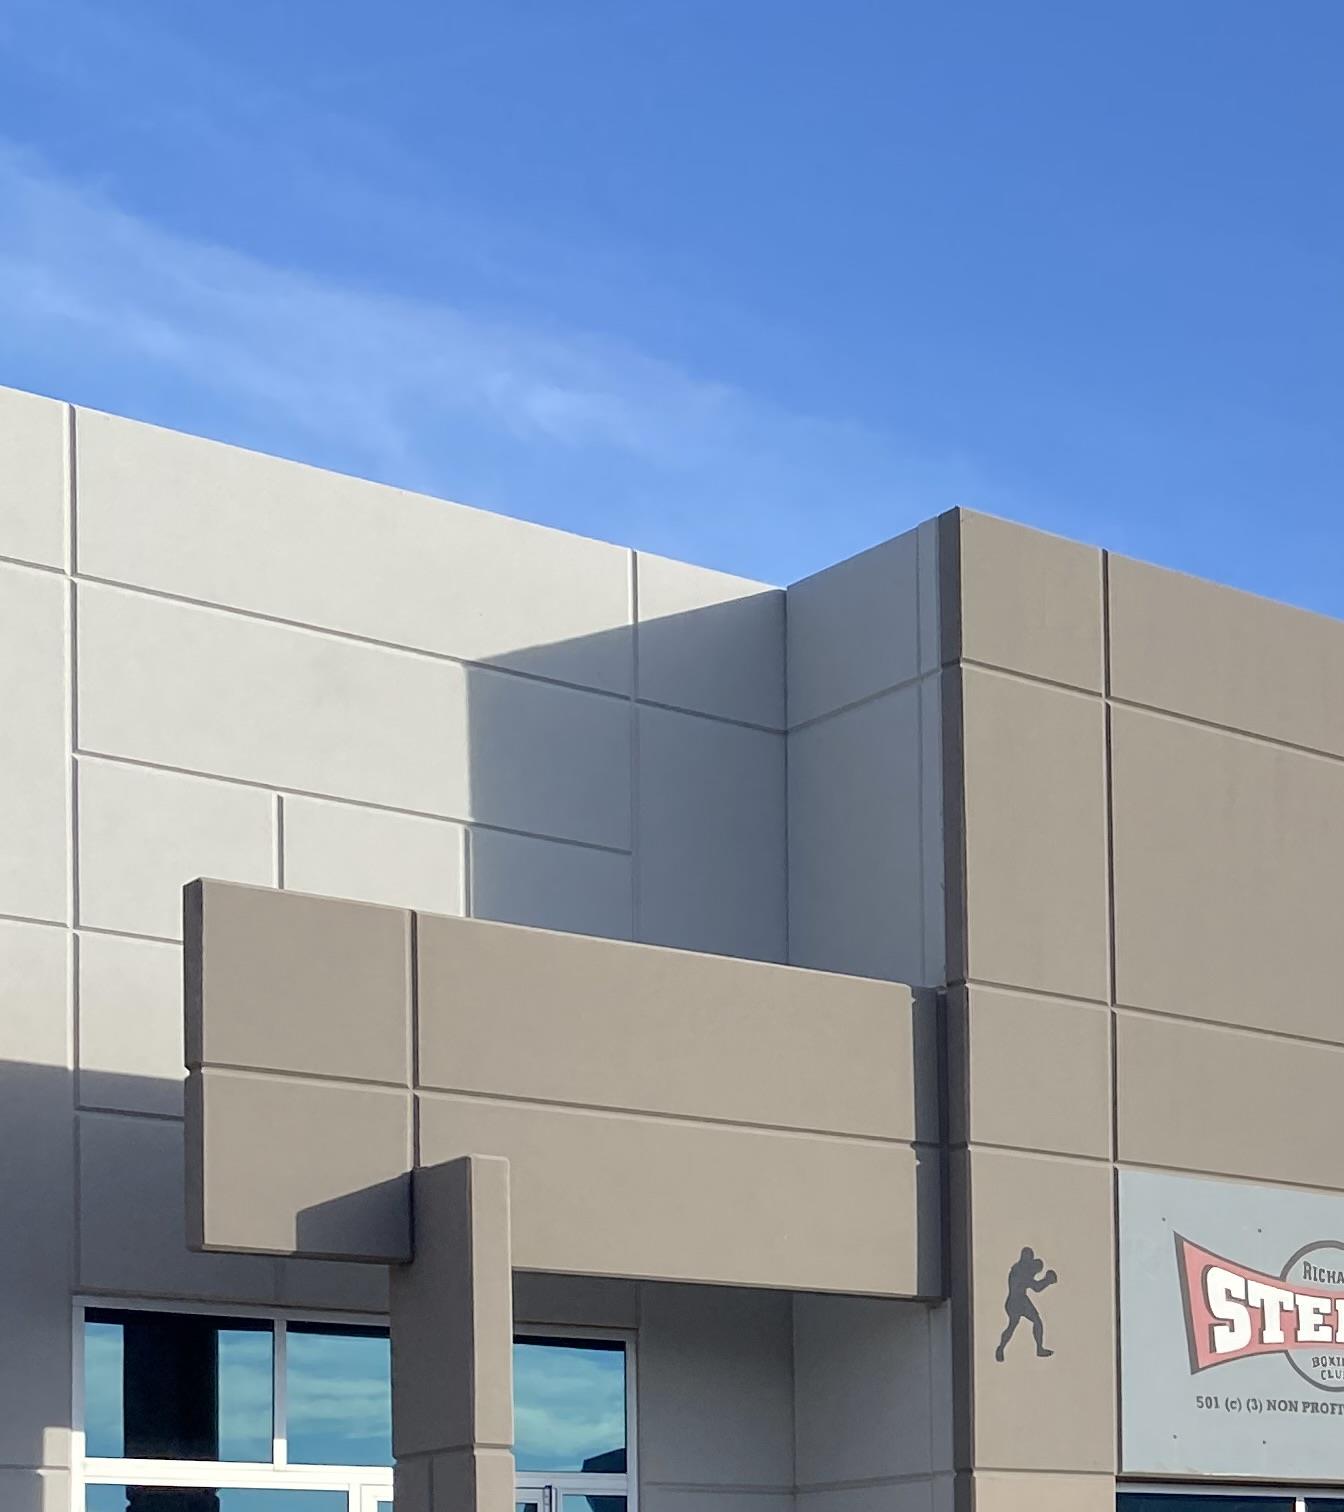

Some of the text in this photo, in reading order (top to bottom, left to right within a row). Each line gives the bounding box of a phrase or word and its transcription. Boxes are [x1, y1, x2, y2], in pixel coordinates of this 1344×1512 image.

[1196, 1396, 1220, 1409] 501
[1225, 1398, 1242, 1413] (c)
[1247, 1398, 1263, 1414] (3)
[1267, 1399, 1299, 1413] NON
